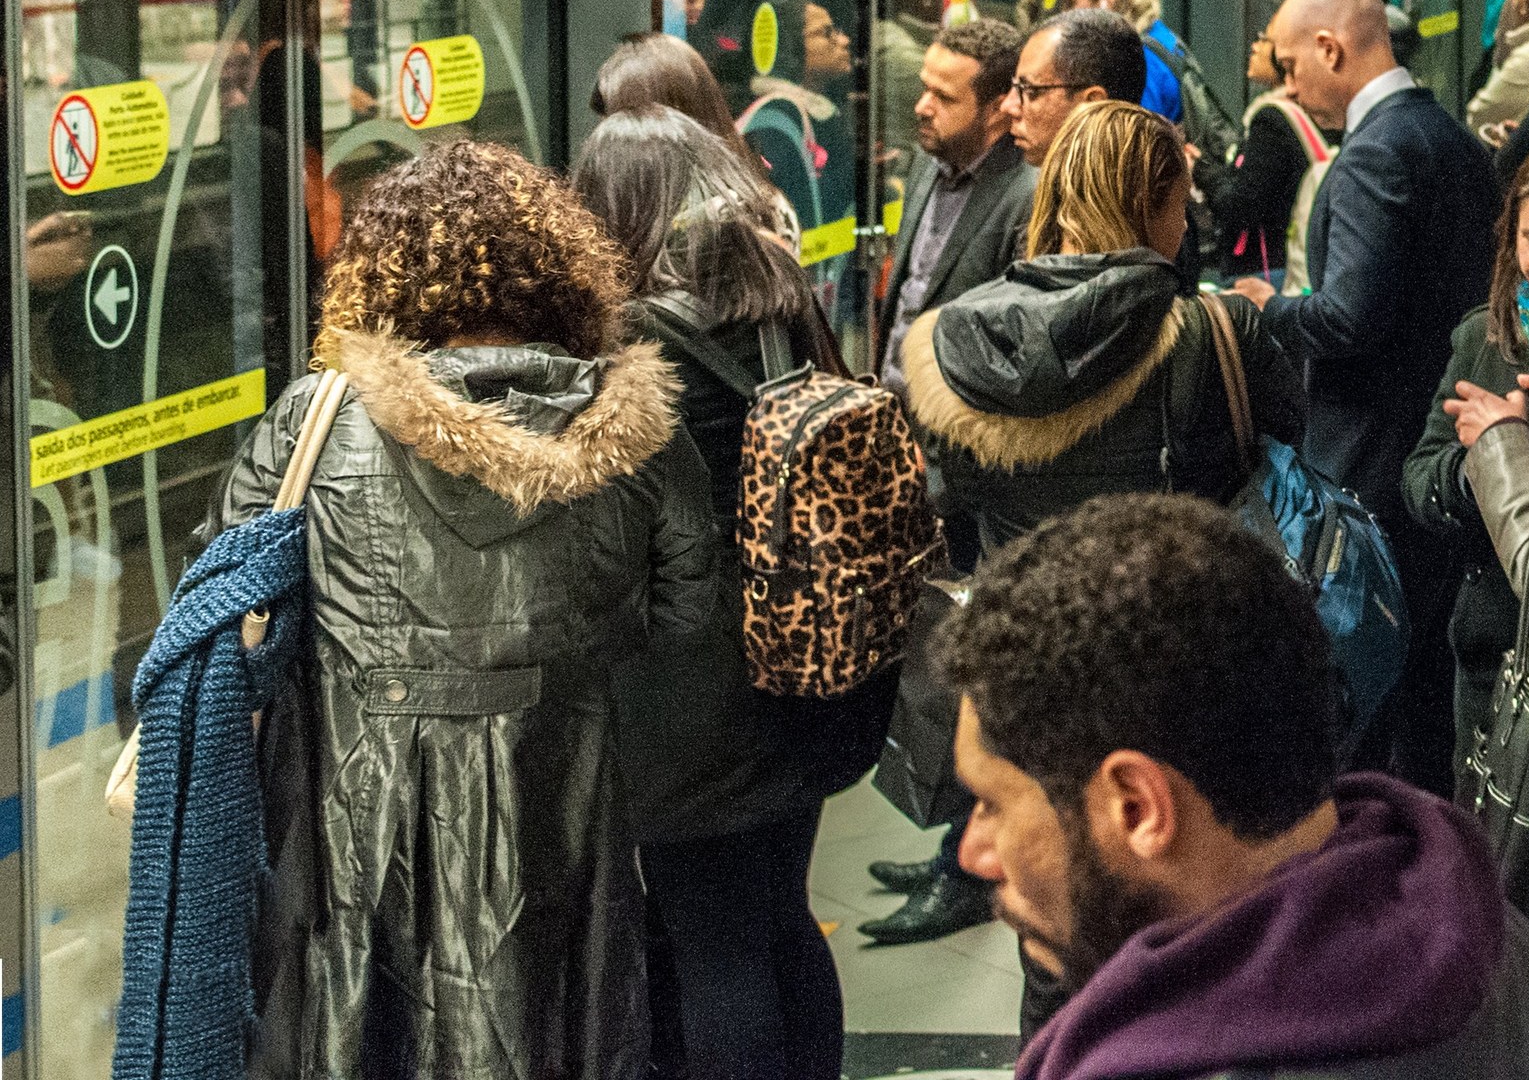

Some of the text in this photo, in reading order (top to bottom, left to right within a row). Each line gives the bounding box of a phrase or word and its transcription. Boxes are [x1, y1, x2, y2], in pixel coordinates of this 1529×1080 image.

[66, 431, 88, 452] dos
[153, 405, 181, 424] antes
[182, 398, 196, 415] de
